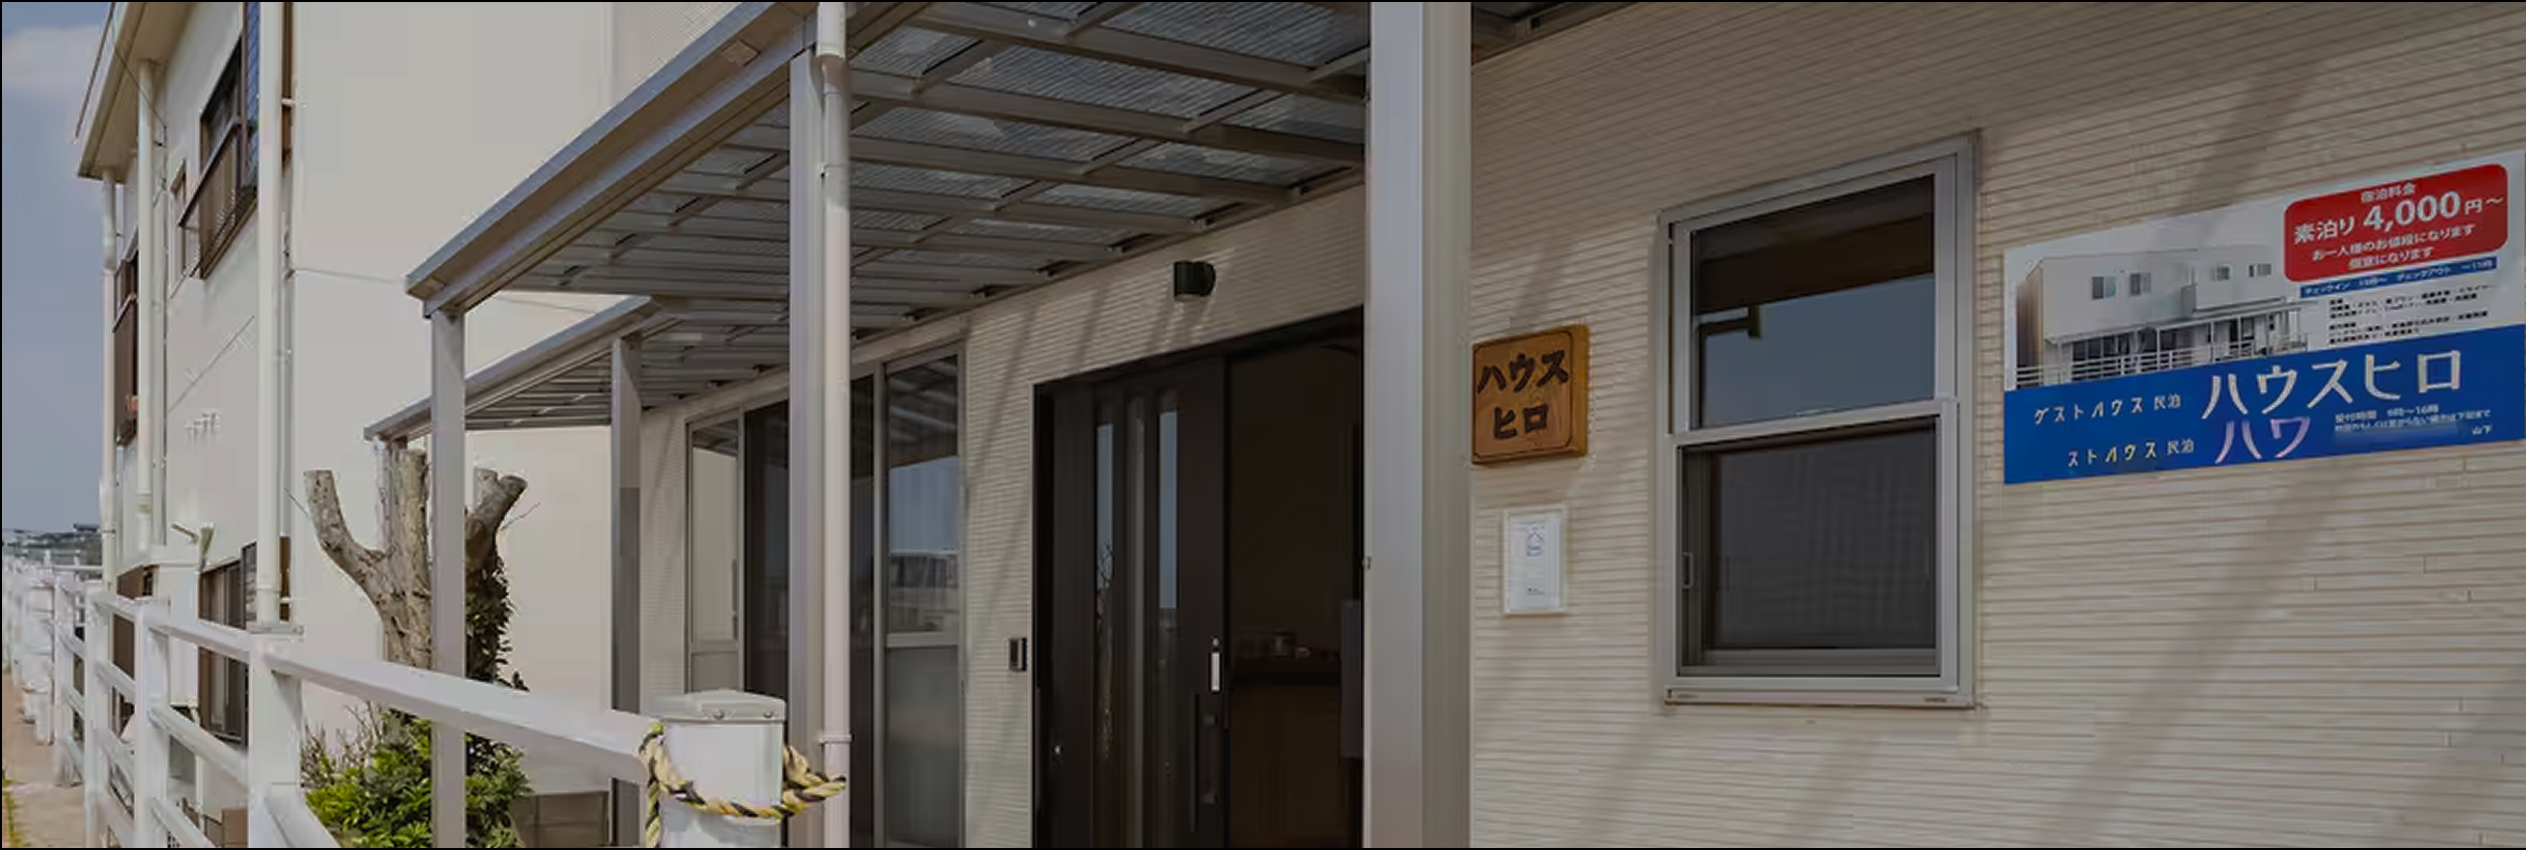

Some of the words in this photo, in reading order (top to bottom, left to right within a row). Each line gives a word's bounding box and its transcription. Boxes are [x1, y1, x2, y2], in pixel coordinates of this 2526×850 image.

[2294, 216, 2354, 244] 素泊り
[2312, 223, 2476, 261] お一人様のお値段になります
[1477, 350, 1569, 394] ハウス
[2034, 397, 2143, 425] ゲストハウス
[2201, 350, 2461, 420] ハウスヒロ
[1494, 404, 1549, 440] ヒロ
